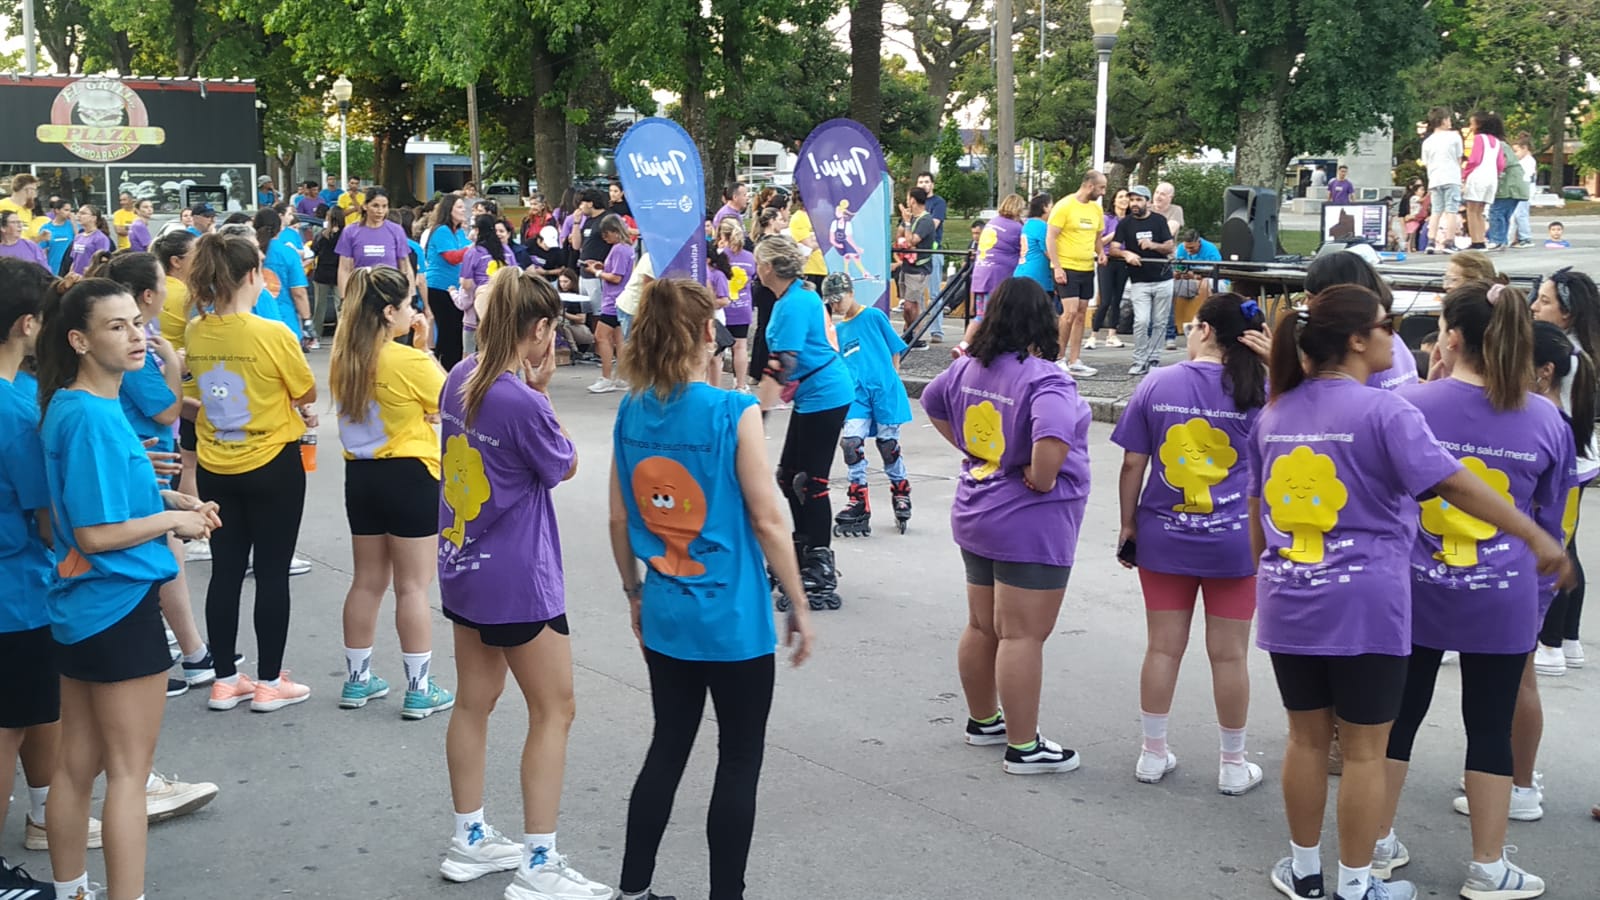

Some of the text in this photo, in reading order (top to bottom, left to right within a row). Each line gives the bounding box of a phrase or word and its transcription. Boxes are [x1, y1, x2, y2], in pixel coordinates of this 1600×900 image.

[65, 127, 139, 142] PLAZA
[120, 170, 129, 181] 4
[1152, 403, 1189, 414] Hablemos
[1189, 406, 1201, 415] de
[1202, 408, 1220, 418] salud
[1461, 443, 1476, 454] de
[1476, 446, 1504, 457] salud
[1504, 450, 1538, 462] mental
